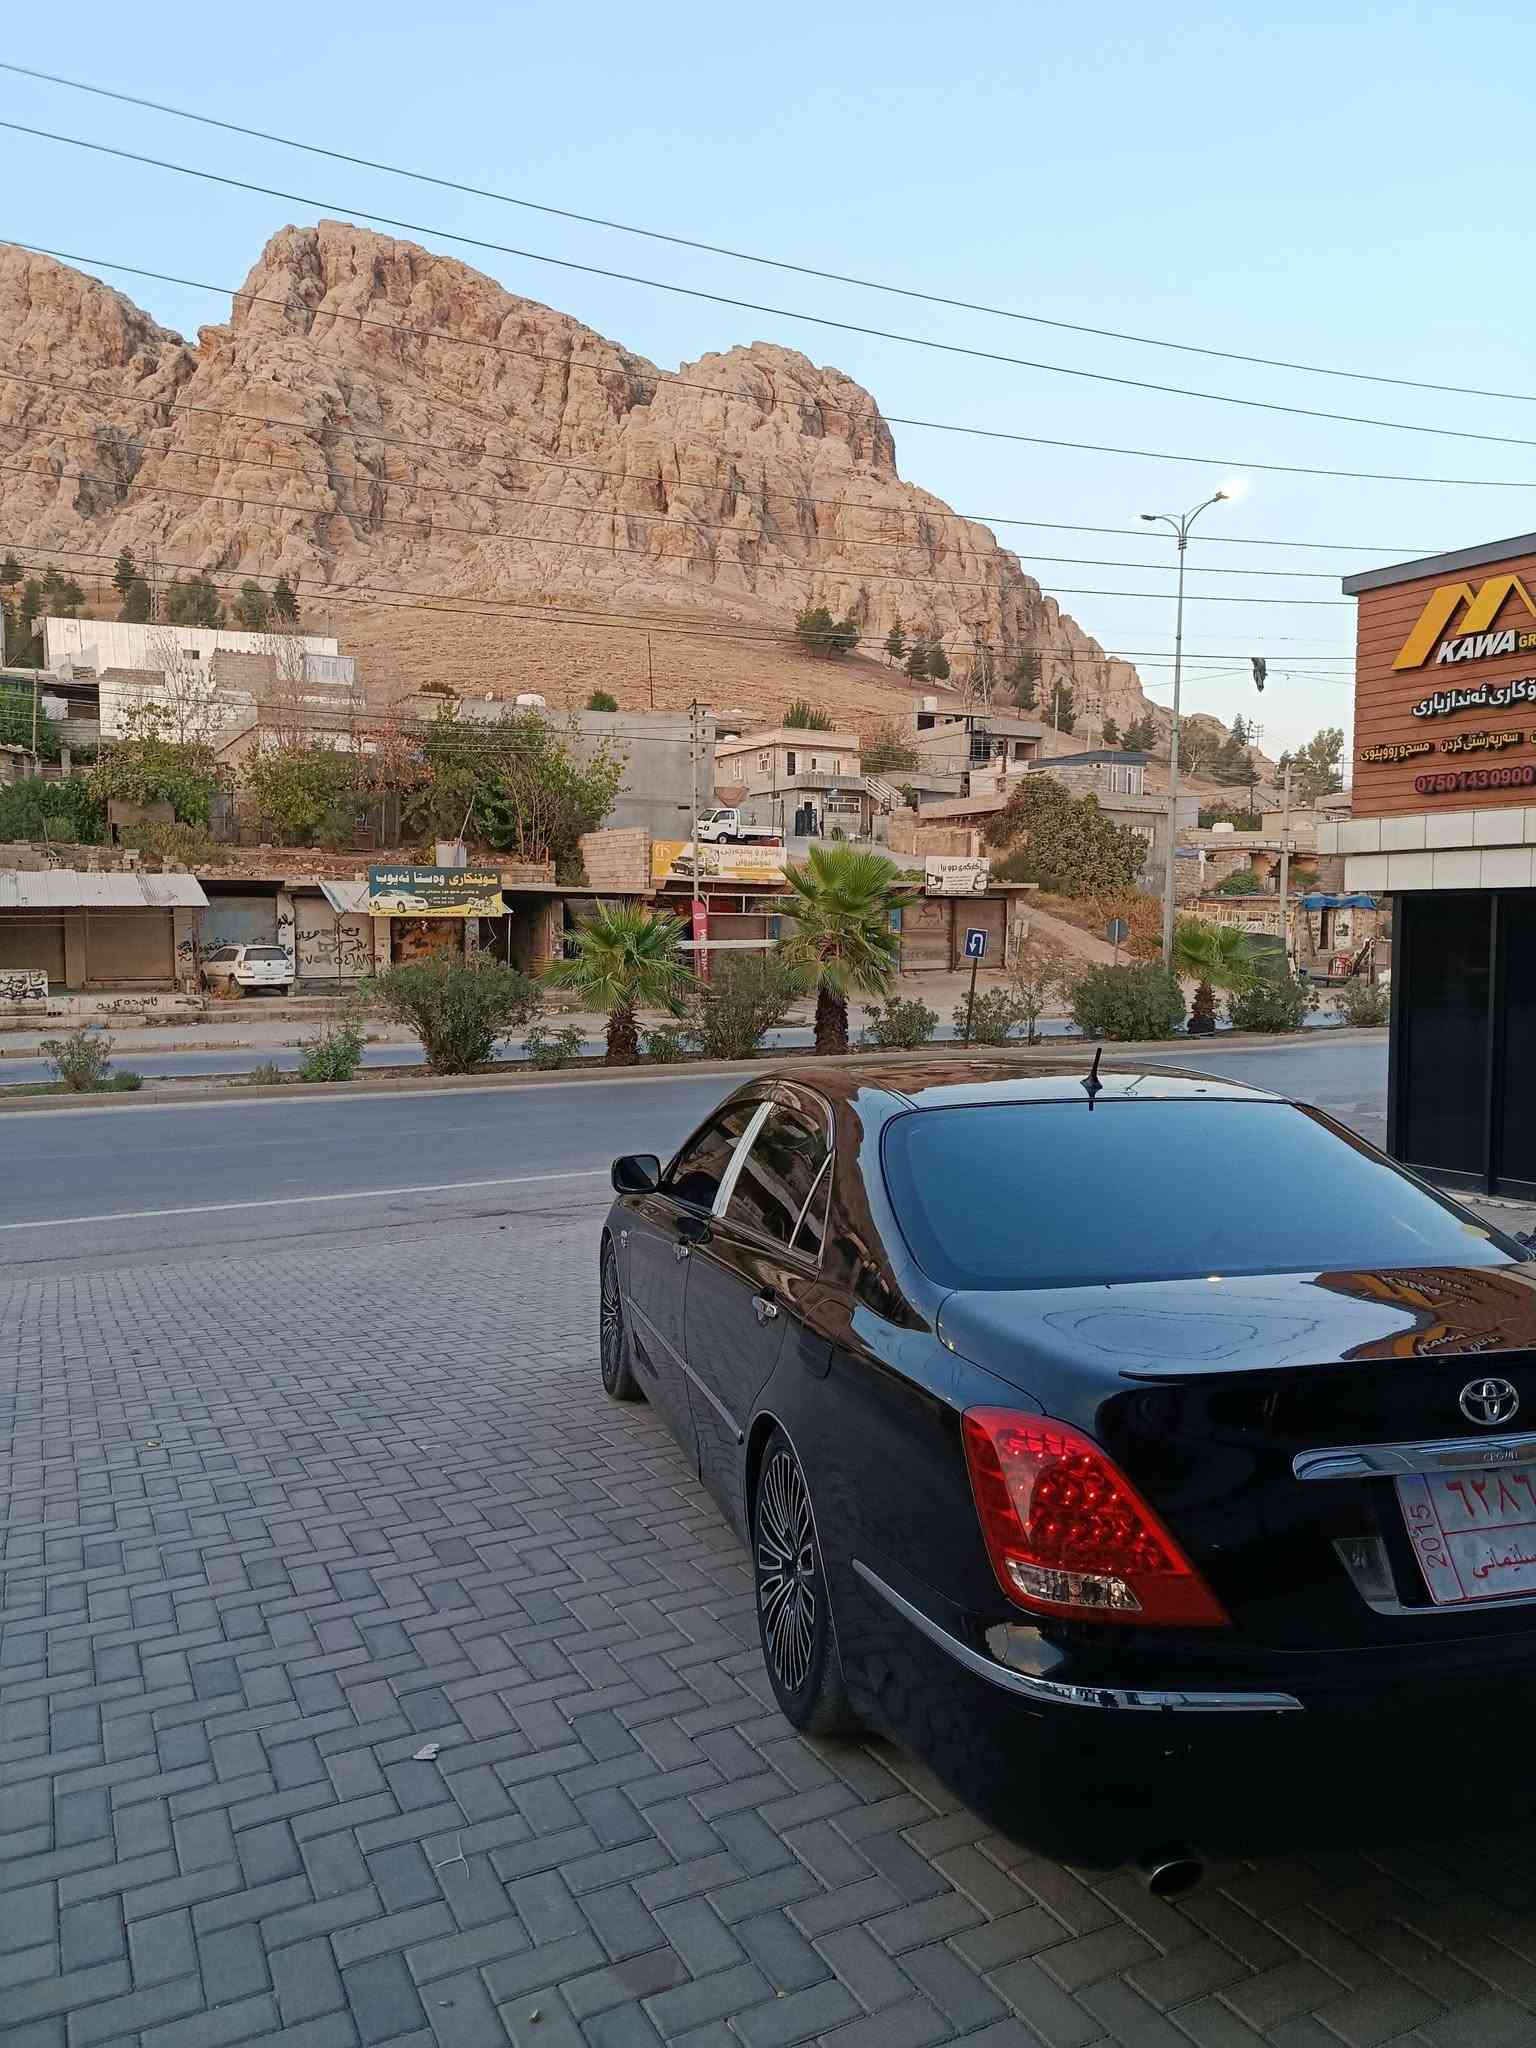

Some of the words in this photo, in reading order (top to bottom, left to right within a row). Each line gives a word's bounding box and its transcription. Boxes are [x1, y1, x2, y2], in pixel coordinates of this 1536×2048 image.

[1435, 629, 1516, 664] KAWA
[1412, 684, 1487, 716] ئەندازیاری
[1410, 1503, 1448, 1569] 2015
